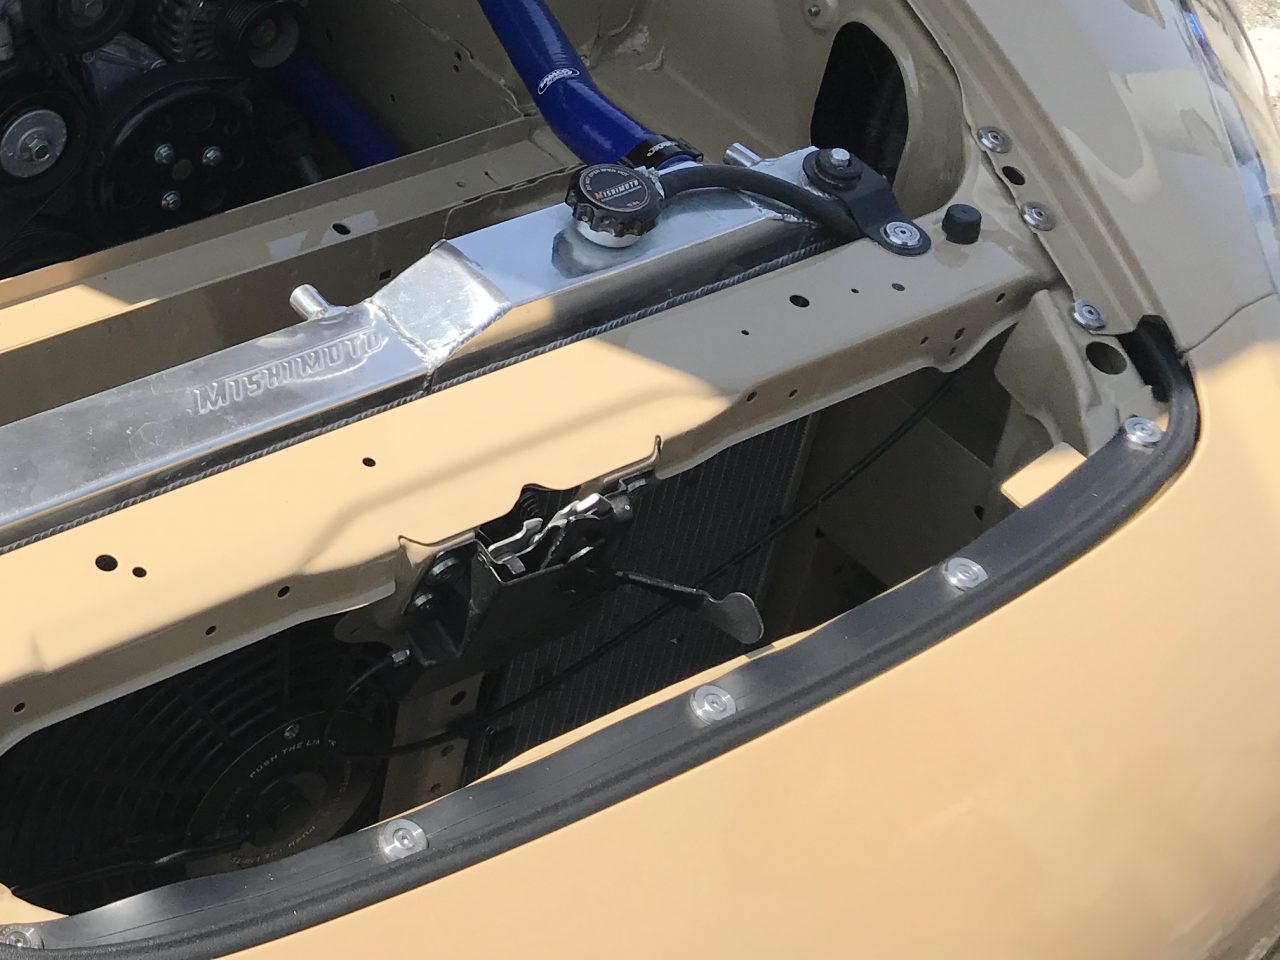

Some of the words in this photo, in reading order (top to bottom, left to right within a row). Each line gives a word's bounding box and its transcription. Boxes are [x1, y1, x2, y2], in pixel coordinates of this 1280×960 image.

[594, 178, 640, 200] MISHIMOTO
[192, 332, 384, 416] MISHIMOTO
[281, 742, 303, 755] THE
